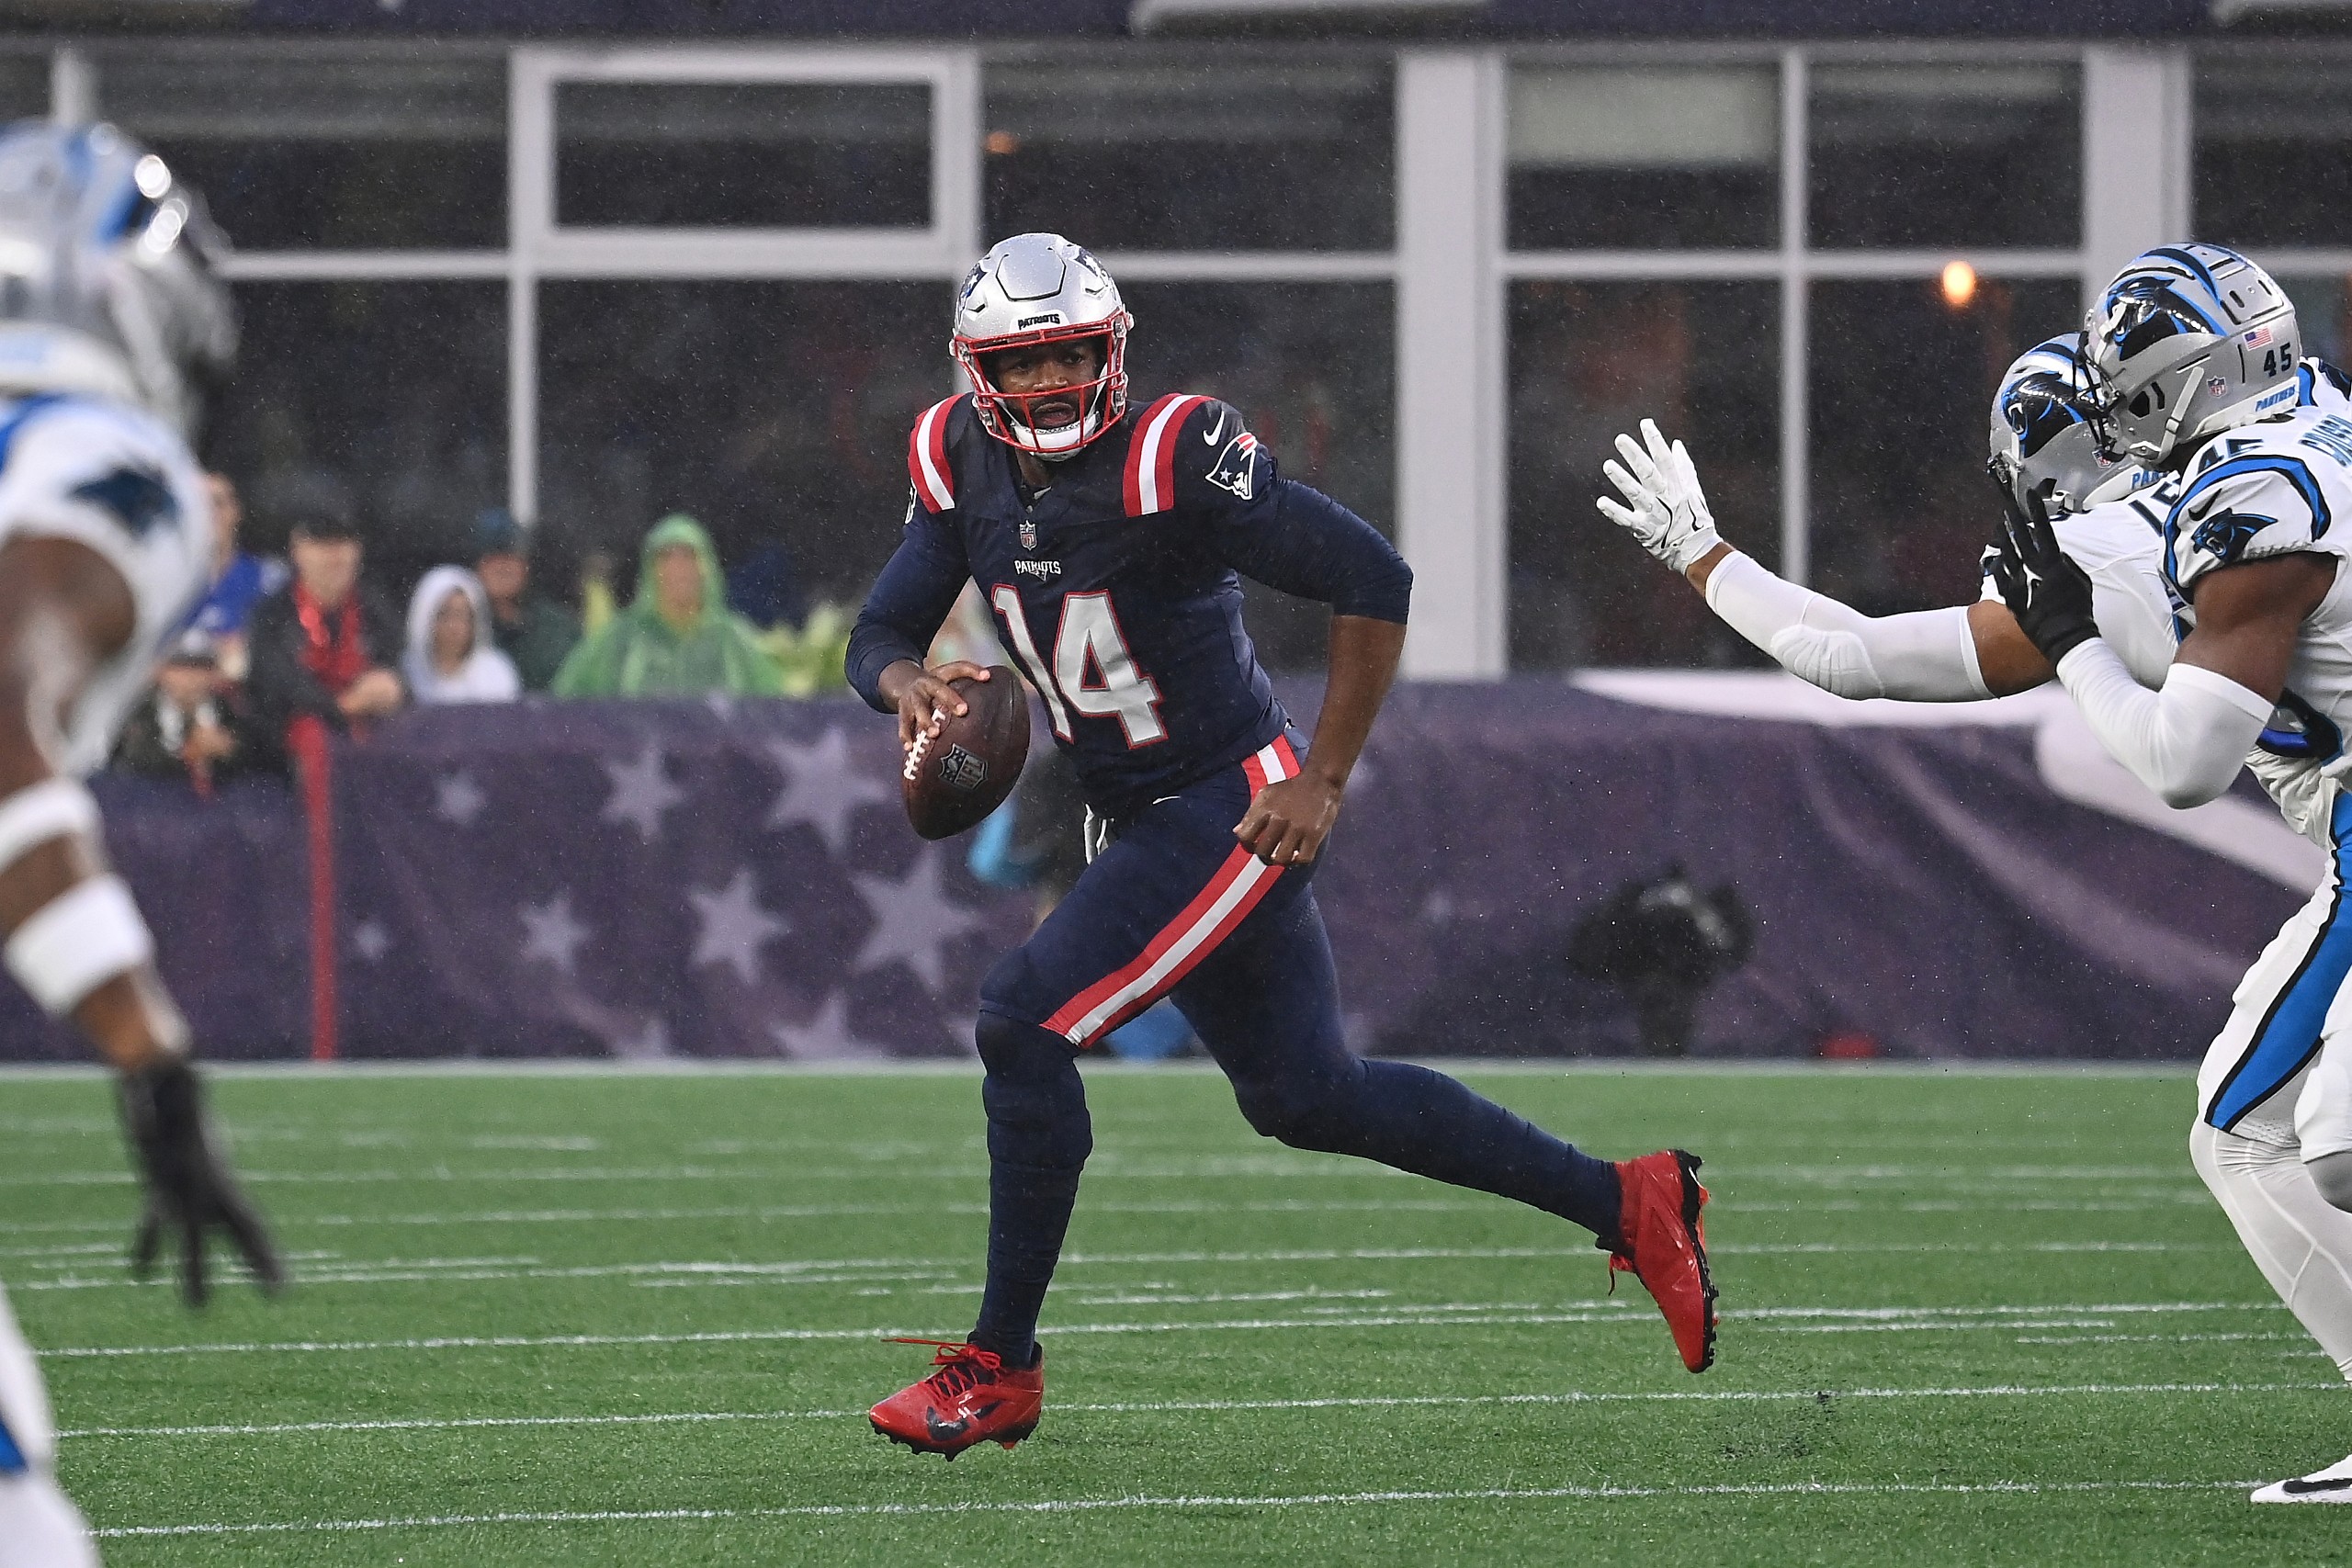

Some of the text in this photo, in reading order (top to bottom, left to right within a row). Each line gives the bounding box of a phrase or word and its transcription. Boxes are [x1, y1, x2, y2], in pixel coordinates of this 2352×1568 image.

[1018, 313, 1060, 331] PATRIOTS
[2263, 343, 2292, 378] 45
[1014, 560, 1061, 575] PATRIOTS
[991, 582, 1169, 750] 14
